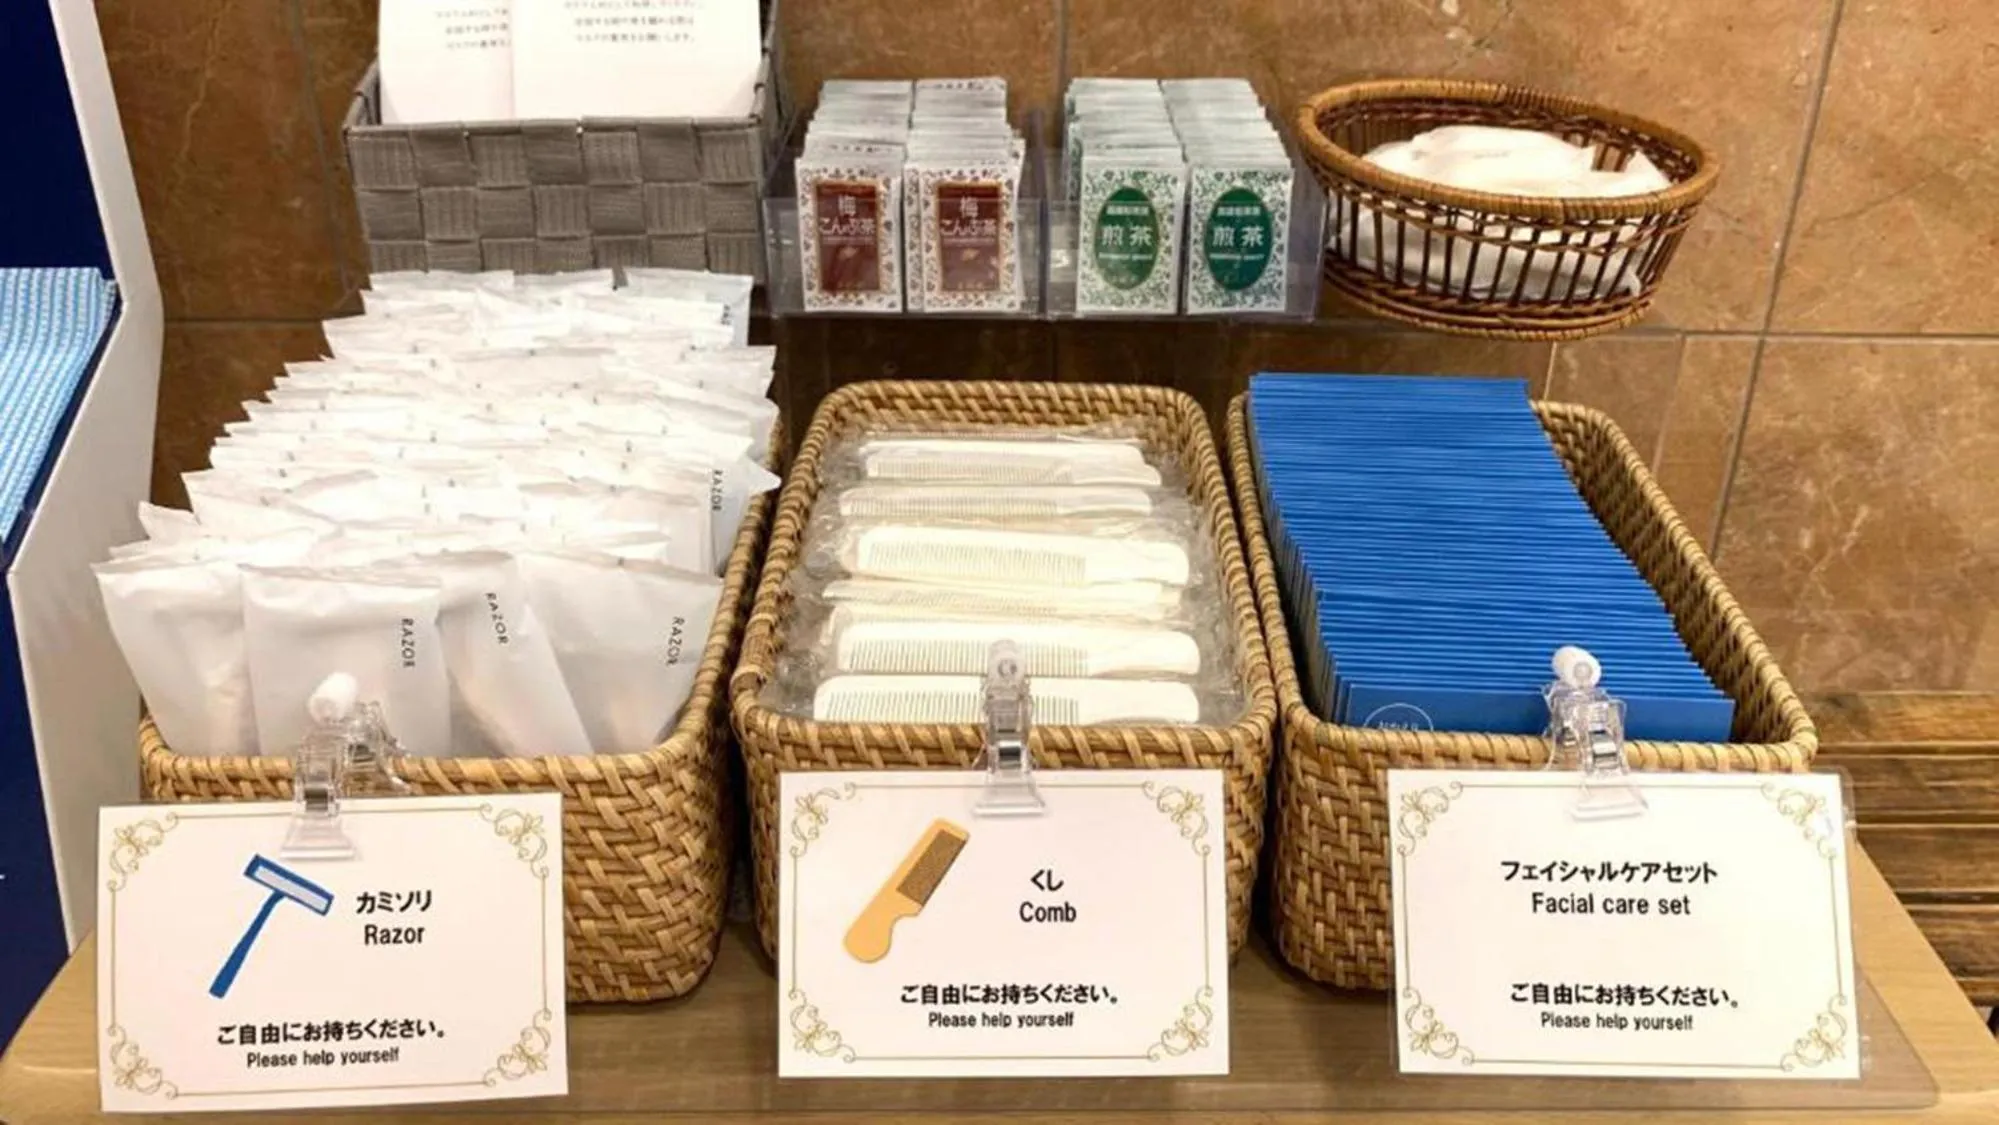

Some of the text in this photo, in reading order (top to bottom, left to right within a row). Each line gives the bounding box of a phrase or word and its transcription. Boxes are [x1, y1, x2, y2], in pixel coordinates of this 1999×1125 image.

[484, 591, 509, 645] RAZOR
[401, 617, 416, 668] RAZOR
[666, 616, 686, 666] RAZOR
[1030, 869, 1065, 893] くし
[1500, 860, 1719, 884] フェイシャルケアセット
[356, 890, 434, 915] カミソリ
[1019, 900, 1077, 924] Comb
[1531, 891, 1691, 915] Facial care set
[364, 922, 425, 947] Razor
[900, 983, 1119, 1006] ご自由にお持ちください。
[1510, 982, 1739, 1009] ご自由にお持ちください。
[217, 1018, 446, 1046] ご自由にお持ちください。
[928, 1011, 1074, 1029] Please help yourself
[1541, 1011, 1694, 1031] Please help yourself
[246, 1047, 400, 1068] Please help yourself
